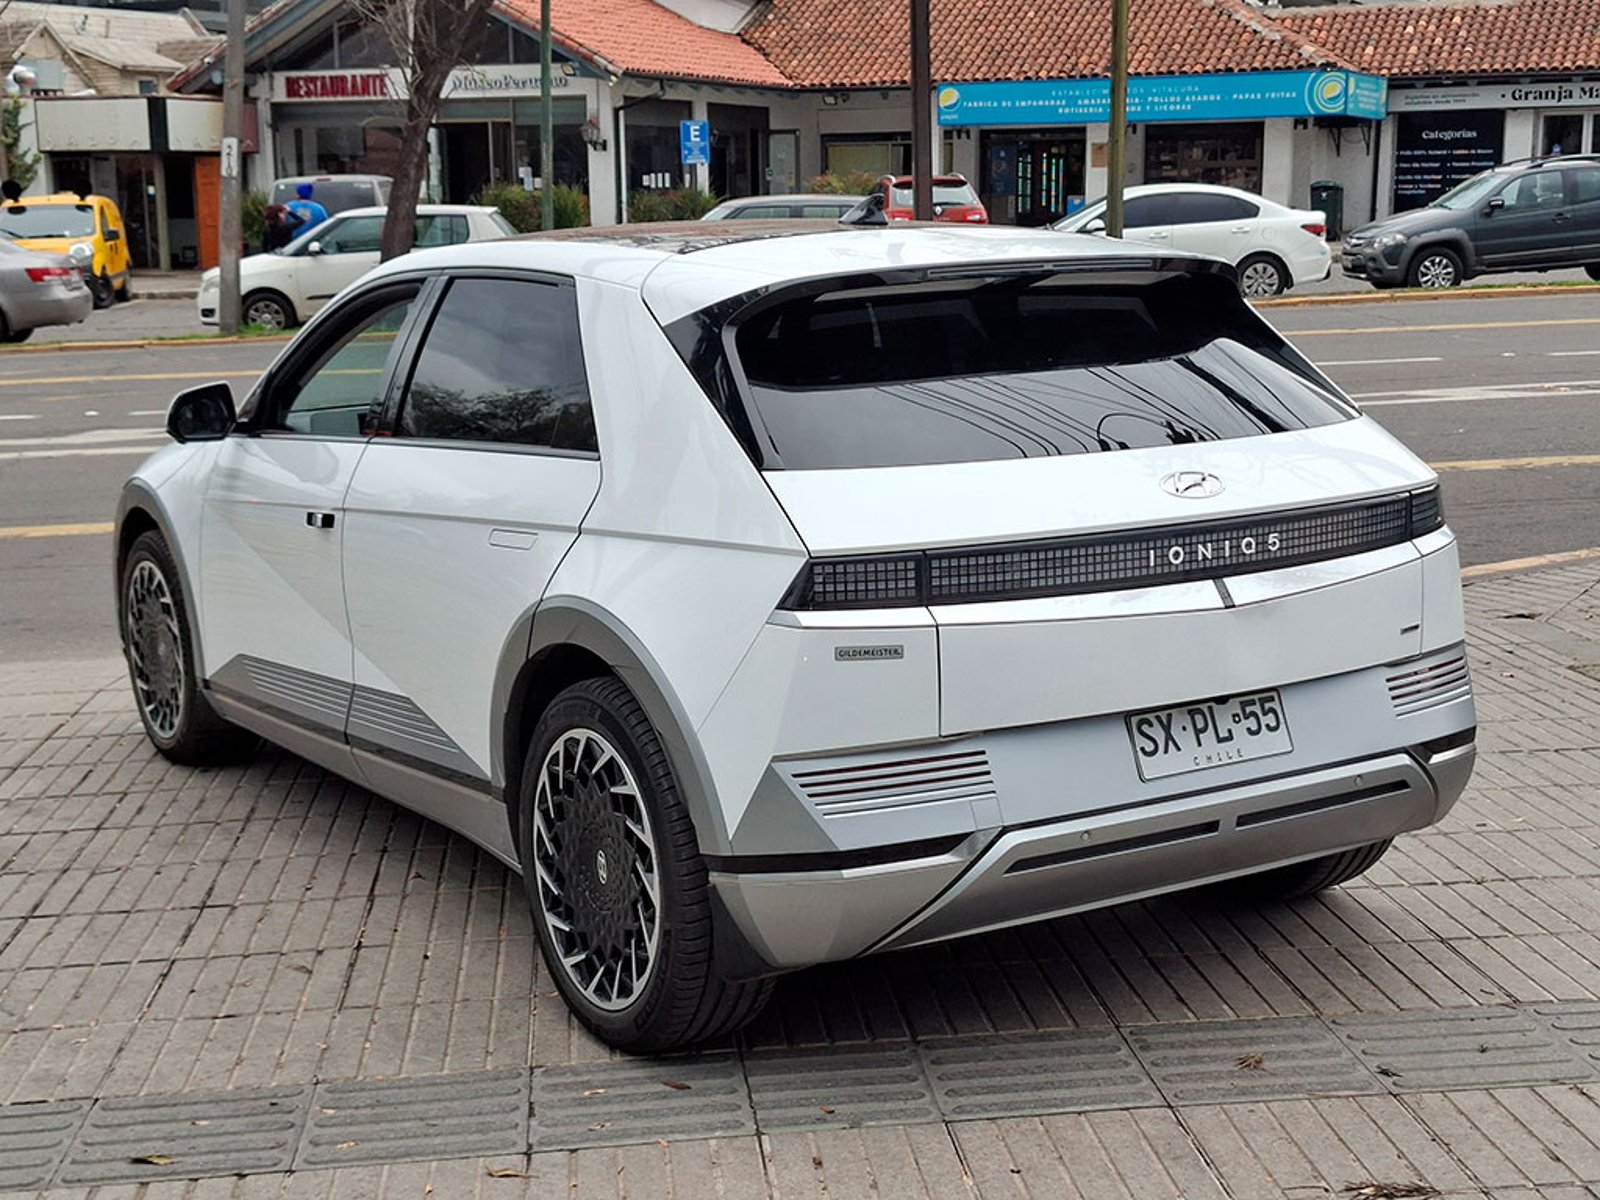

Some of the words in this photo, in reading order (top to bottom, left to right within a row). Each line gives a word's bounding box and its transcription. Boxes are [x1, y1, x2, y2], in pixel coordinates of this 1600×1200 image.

[286, 74, 387, 98] RESTAURANTE
[1511, 85, 1573, 103] Granja
[1232, 92, 1262, 100] PAPAS
[690, 125, 701, 142] E
[1193, 748, 1245, 766] CHILE
